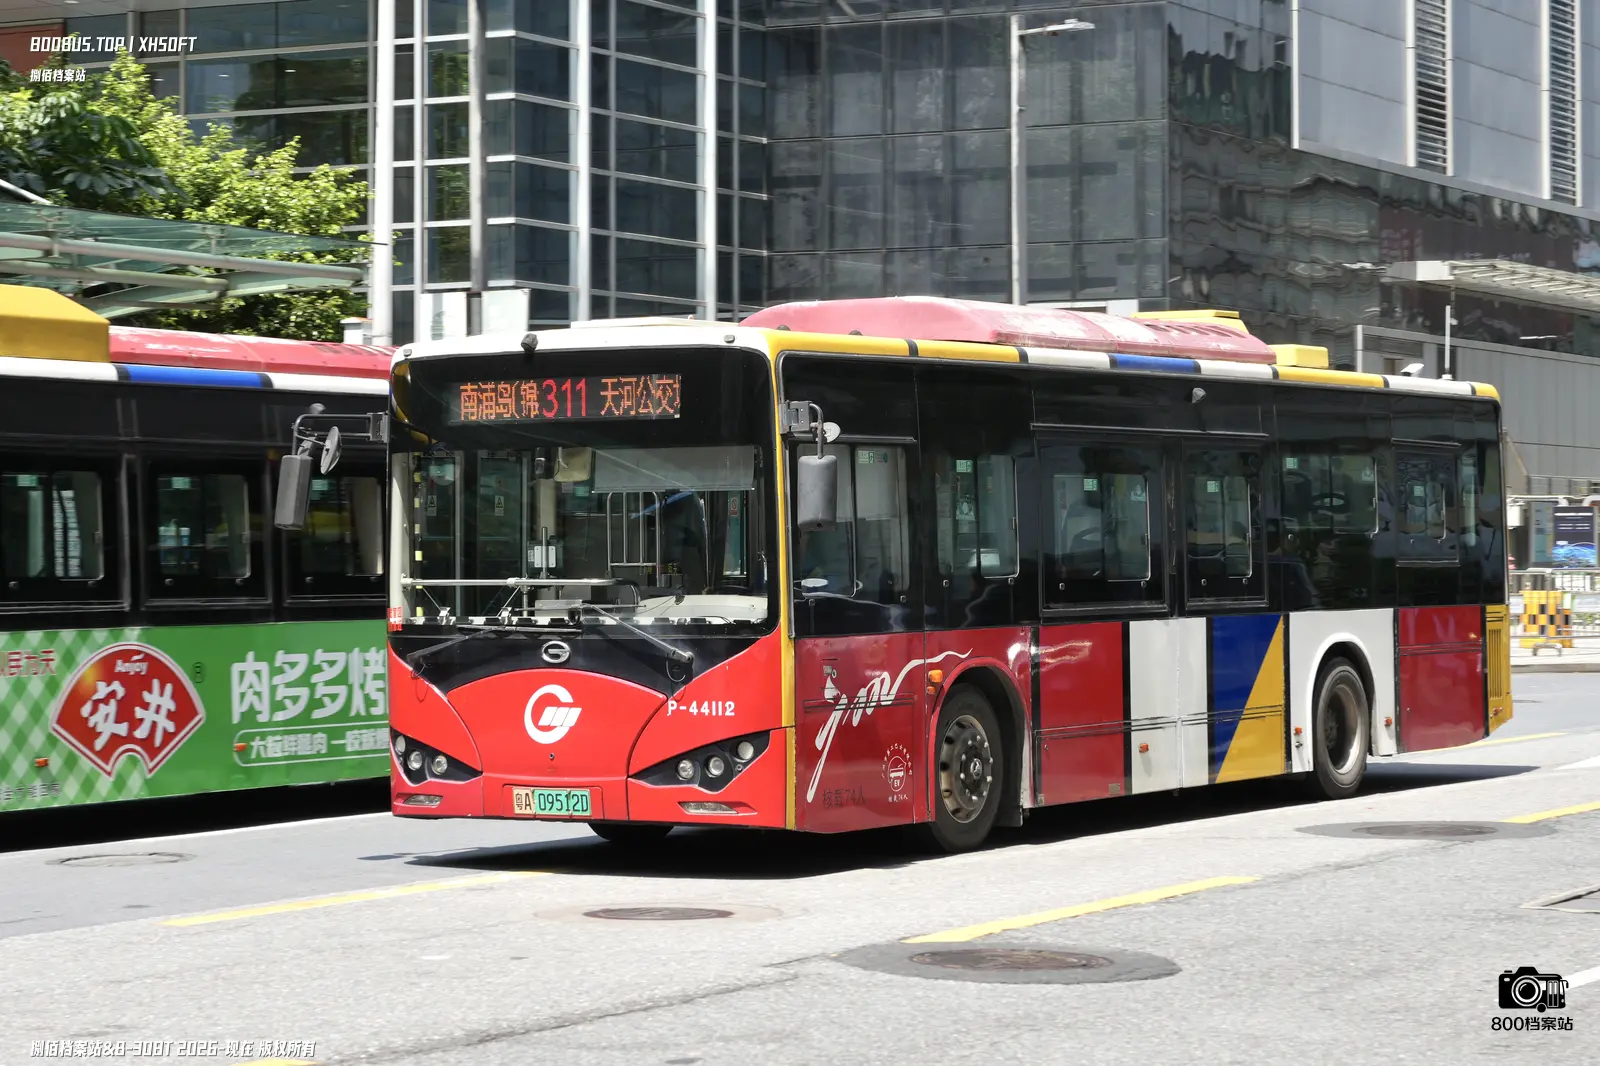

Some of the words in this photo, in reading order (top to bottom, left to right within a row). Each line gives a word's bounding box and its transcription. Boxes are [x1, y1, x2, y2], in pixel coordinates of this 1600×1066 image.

[542, 378, 587, 418] 311
[231, 647, 388, 724] 肉多多烤
[667, 700, 736, 716] P-44112
[80, 678, 177, 752] 安井
